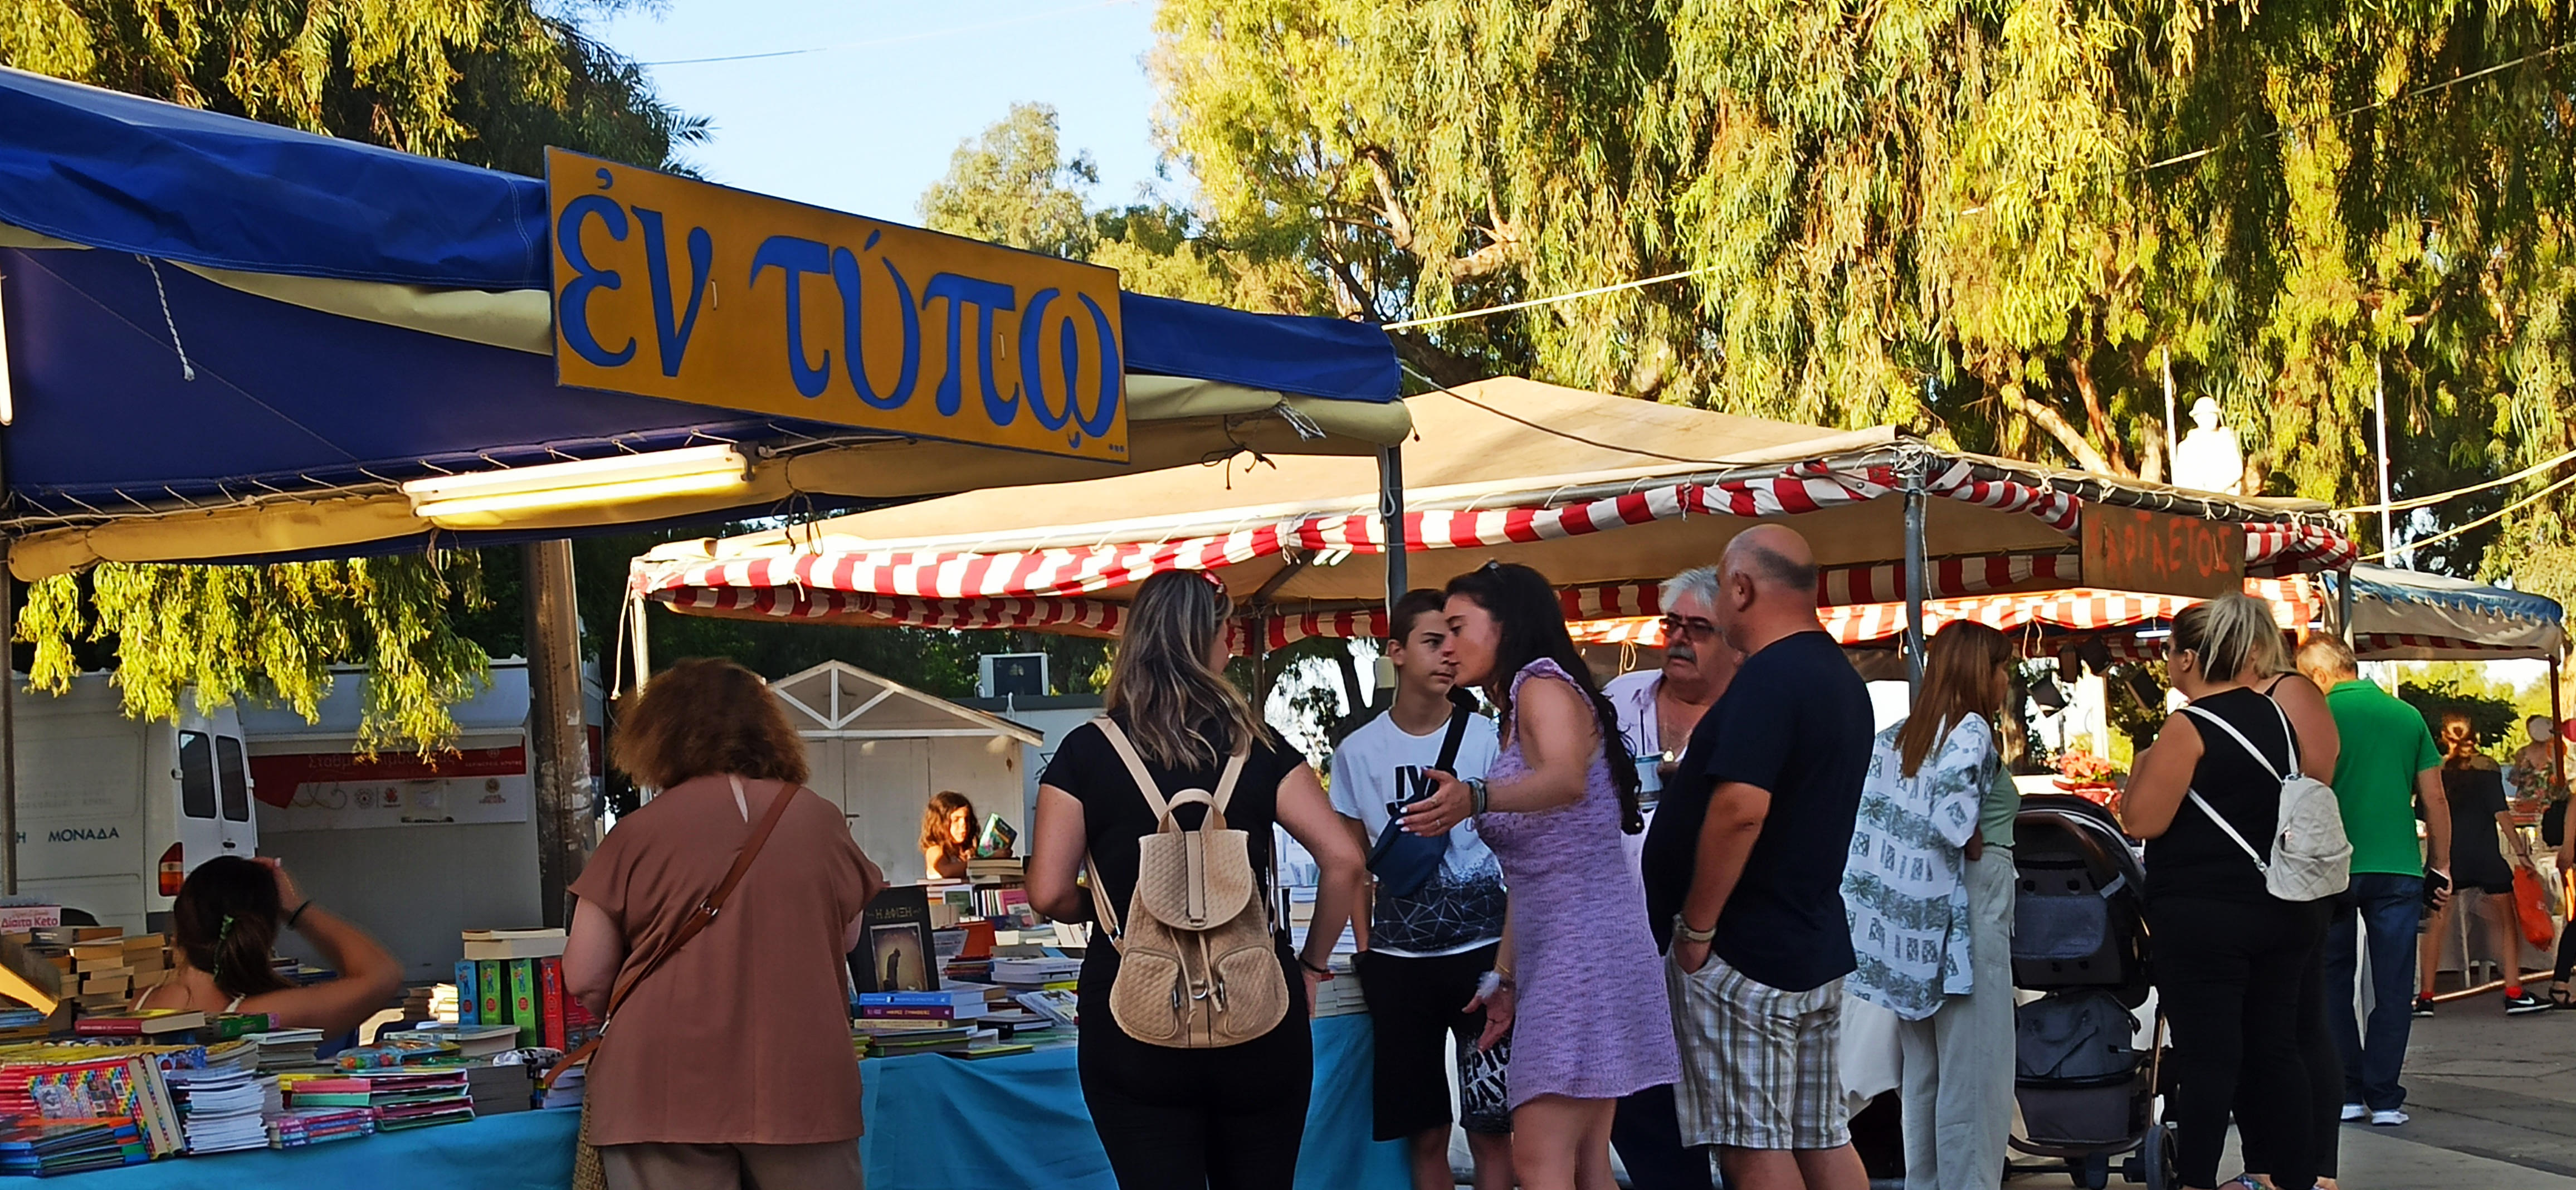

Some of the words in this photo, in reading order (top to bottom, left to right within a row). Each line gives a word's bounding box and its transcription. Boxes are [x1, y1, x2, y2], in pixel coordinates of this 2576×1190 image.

[48, 827, 120, 842] ΜΟΝΑΔΑ
[1, 917, 32, 928] Δίαιτα
[34, 917, 58, 927] Keto
